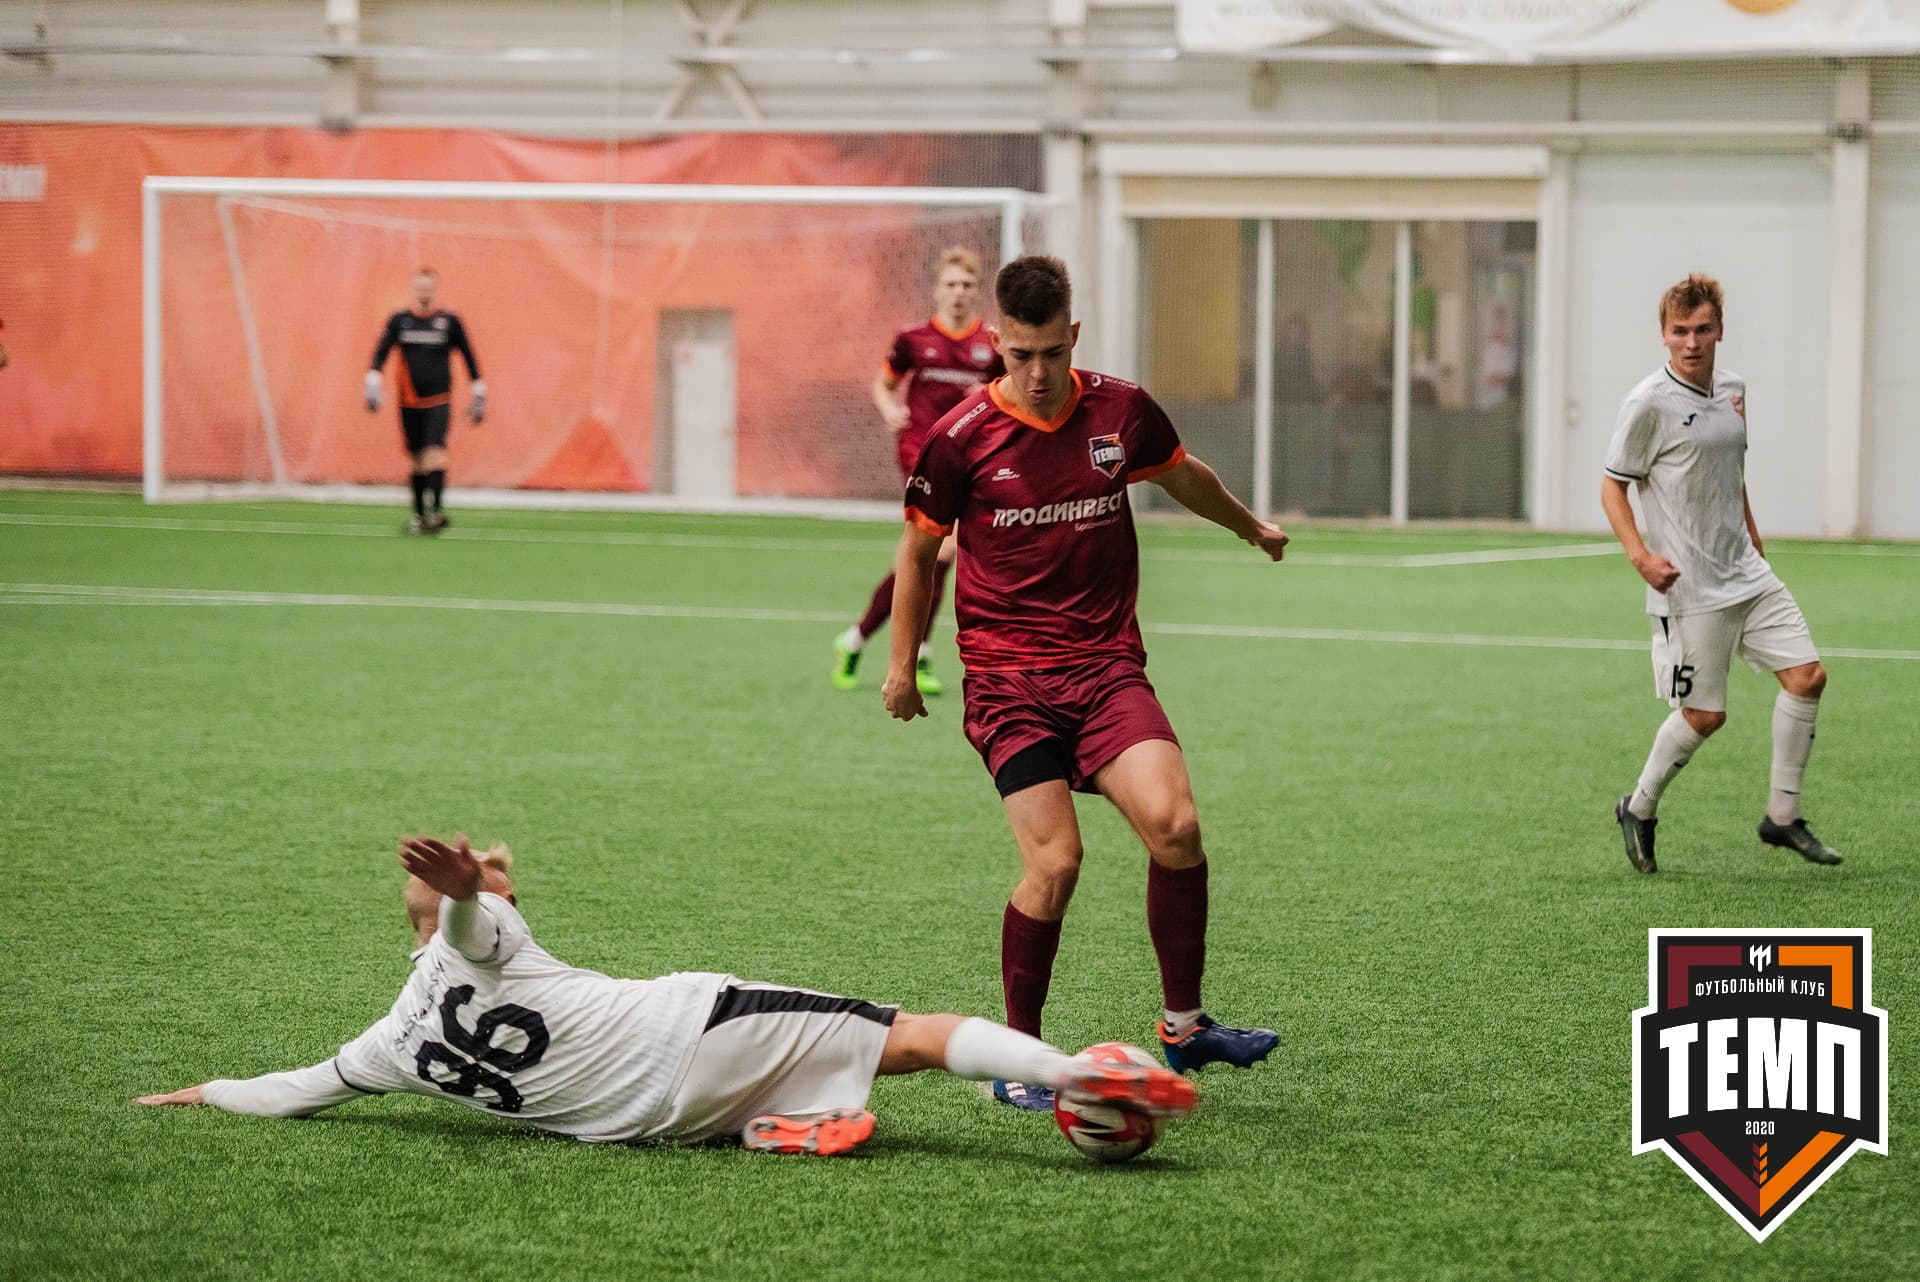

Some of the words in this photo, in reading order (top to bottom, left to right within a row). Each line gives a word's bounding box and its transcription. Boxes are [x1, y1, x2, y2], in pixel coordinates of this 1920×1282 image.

[993, 491, 1123, 528] ПРОДИНВЕСТ
[1671, 664, 1694, 698] 15
[414, 984, 549, 1113] 96
